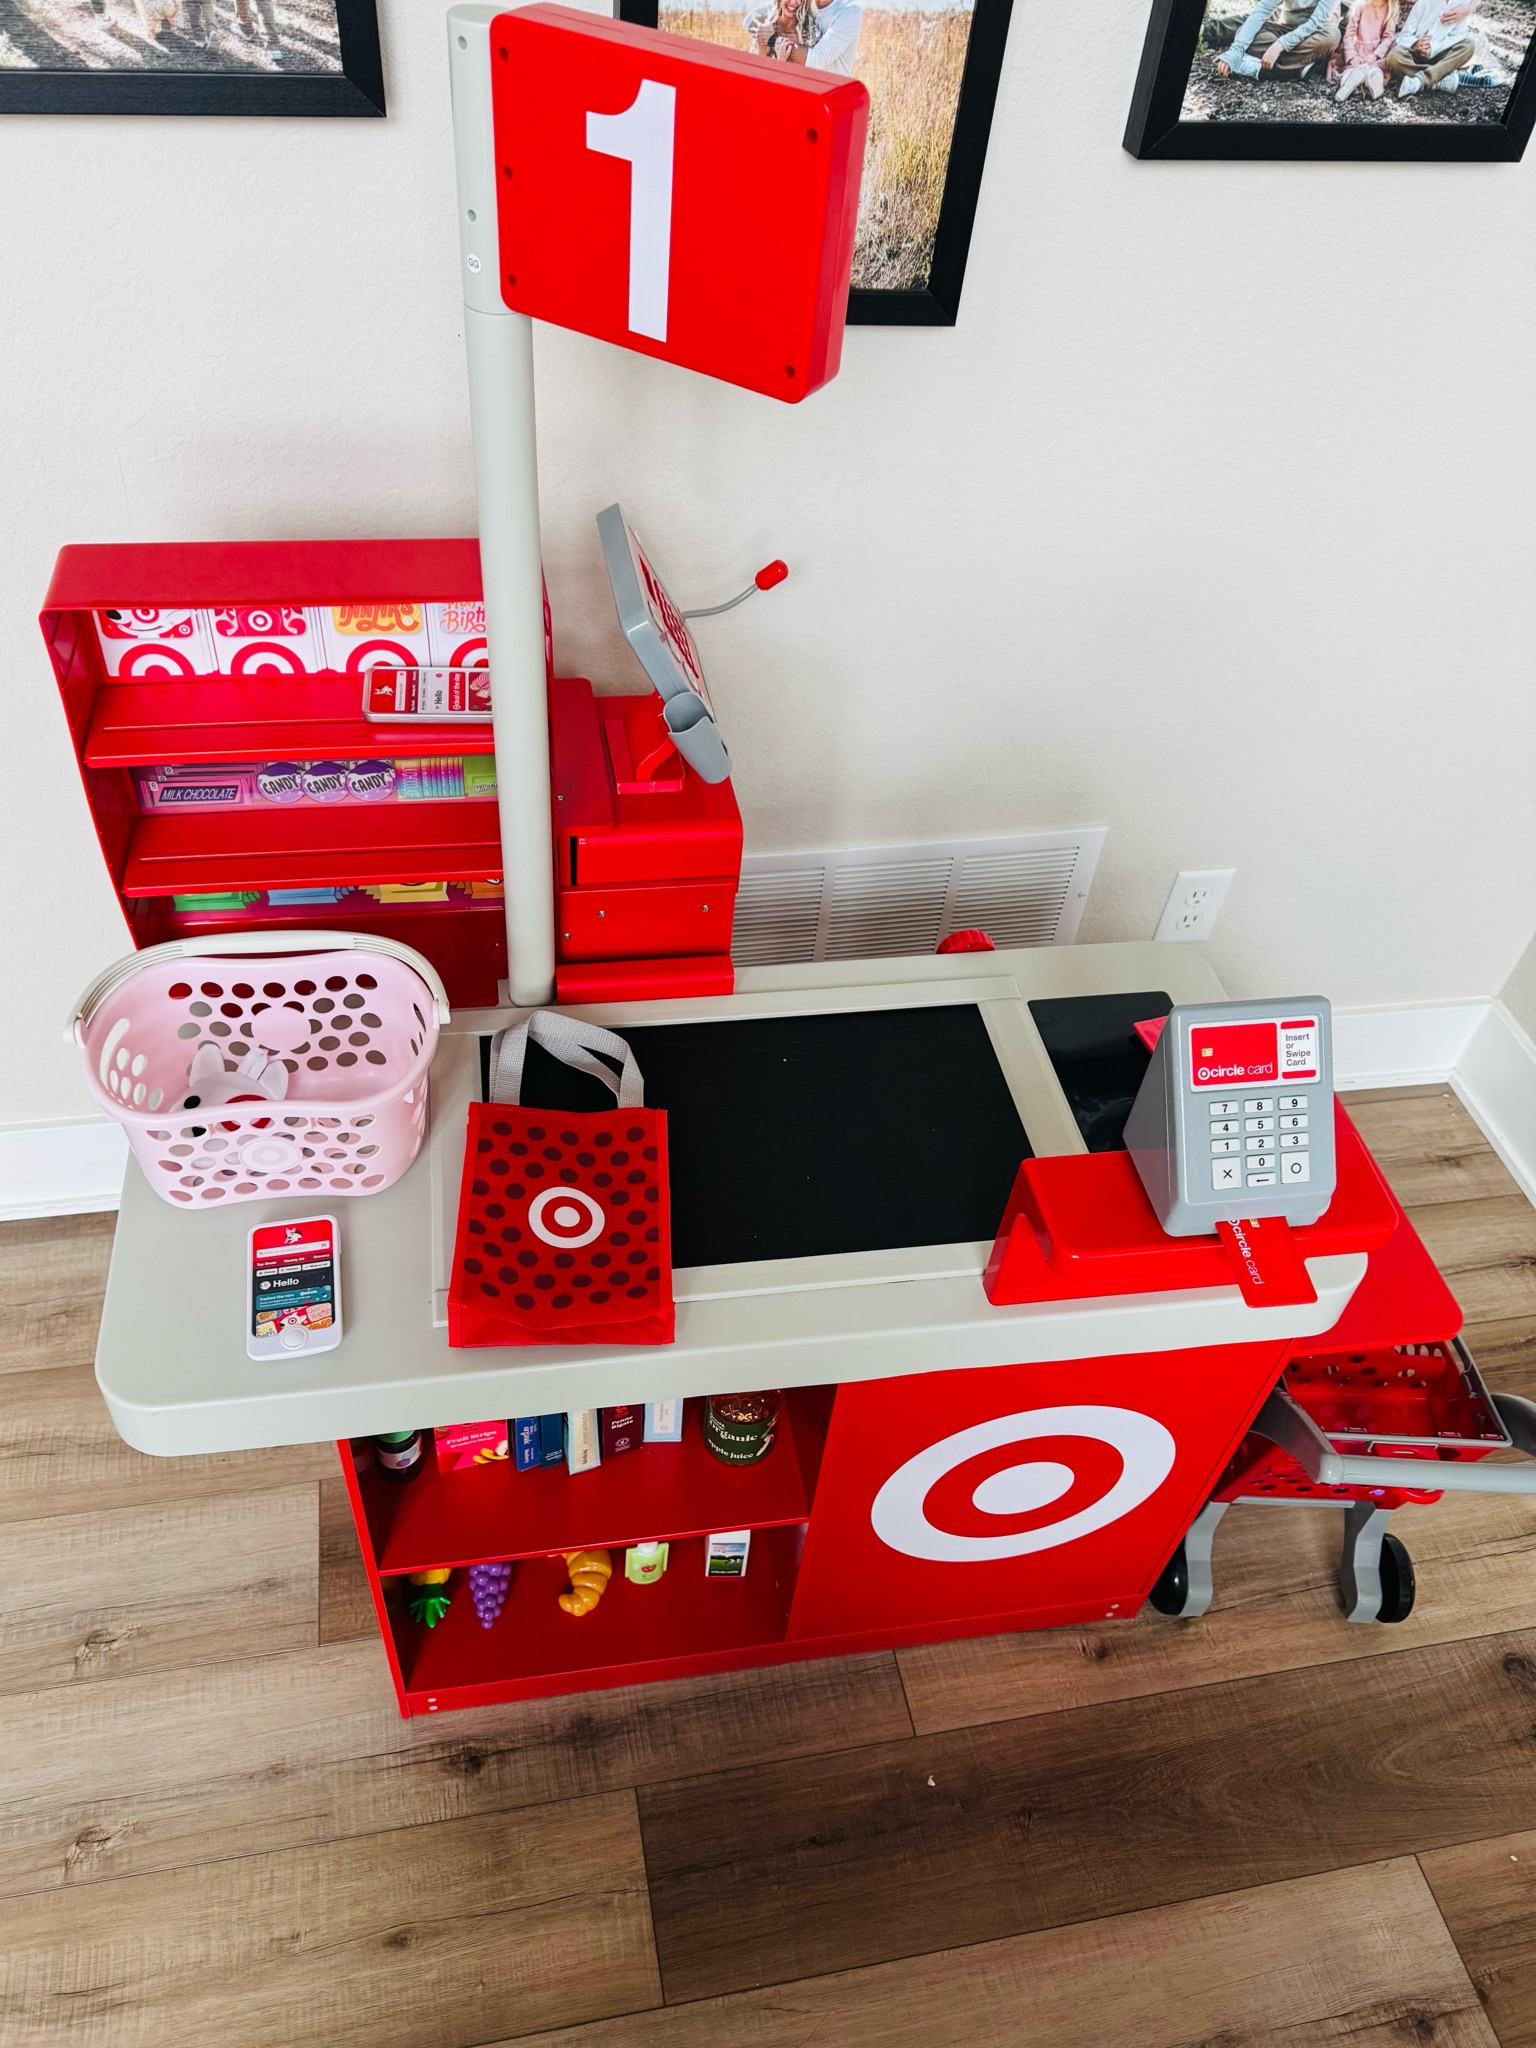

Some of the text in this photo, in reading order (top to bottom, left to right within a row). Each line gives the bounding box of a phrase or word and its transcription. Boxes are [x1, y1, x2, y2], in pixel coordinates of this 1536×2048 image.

[586, 78, 677, 343] 1
[453, 673, 462, 682] day
[434, 689, 443, 705] Hello
[262, 773, 300, 796] CANDY
[306, 773, 343, 795] CANDY
[351, 772, 388, 794] CANDY
[161, 787, 237, 800] MILK CHOCOLATE
[1285, 1032, 1310, 1042] Insert
[1285, 1042, 1294, 1050] or
[1286, 1049, 1311, 1059] Swipe
[1286, 1058, 1307, 1067] Card
[1210, 1061, 1273, 1077] circle card
[1256, 1102, 1263, 1111] 8
[1291, 1099, 1298, 1107] 9
[1222, 1104, 1228, 1113] 7
[1257, 1120, 1264, 1130] 5
[1292, 1118, 1299, 1127] 6
[1222, 1123, 1229, 1132] 4
[1258, 1139, 1265, 1148] 2
[1292, 1136, 1299, 1145] 3
[1224, 1142, 1230, 1150] 1
[1258, 1158, 1265, 1166] 0
[1232, 1227, 1265, 1285] circle card
[273, 1278, 299, 1288] Hello
[446, 1430, 497, 1445] Fruit Strips
[729, 1452, 754, 1460] juice
